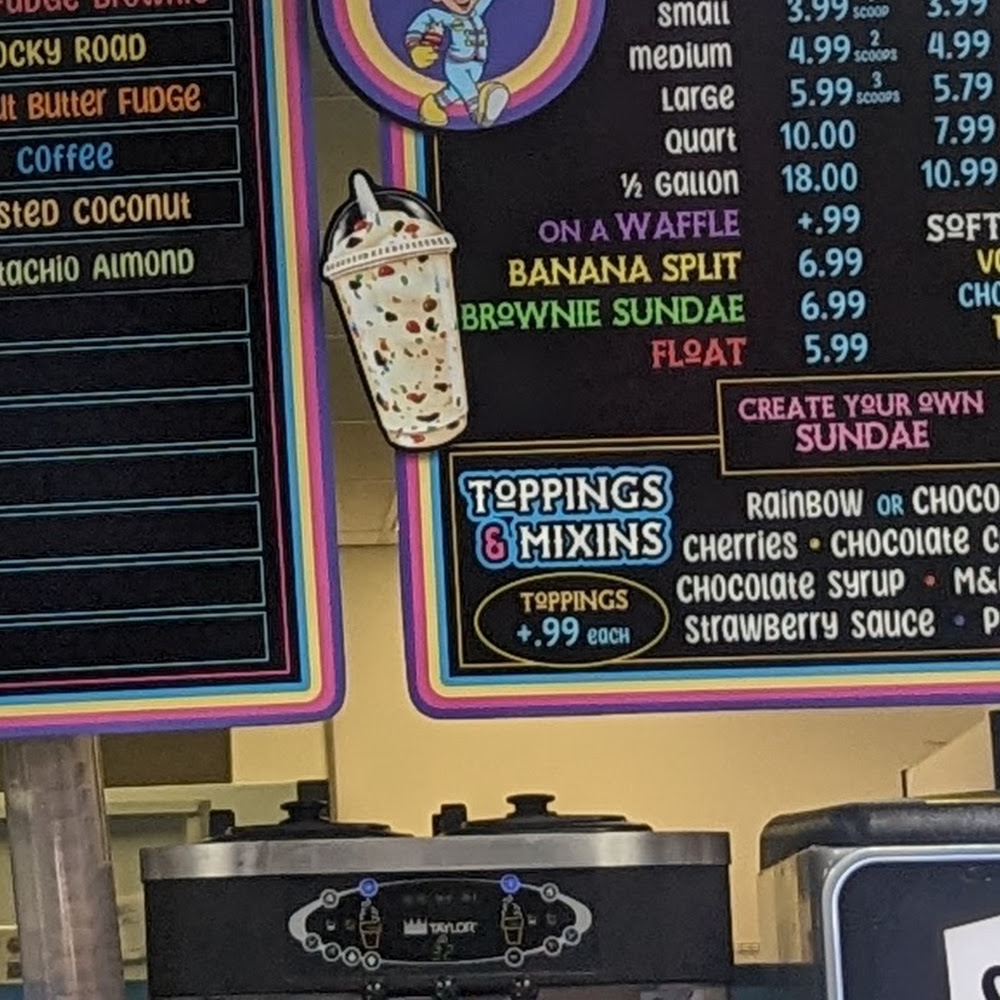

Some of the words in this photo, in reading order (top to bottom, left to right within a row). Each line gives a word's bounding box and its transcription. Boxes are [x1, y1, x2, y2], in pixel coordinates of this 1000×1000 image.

[852, 5, 890, 20] SCOOP
[74, 32, 147, 64] ROaD
[629, 40, 733, 71] MeDium
[788, 34, 851, 65] 4.99
[869, 29, 880, 47] 2
[927, 29, 991, 61] 4.99
[853, 48, 898, 63] SCOOPS
[661, 83, 735, 113] LarGe
[790, 77, 854, 108] 5.99
[871, 70, 882, 89] 3
[933, 71, 994, 102] 5.79
[27, 88, 107, 120] Butter
[117, 83, 201, 115] FUDGe
[856, 90, 901, 105] SCOOPS
[664, 124, 738, 155] Quart
[780, 118, 856, 151] 10.00
[934, 113, 996, 146] 7.99
[16, 141, 114, 175] Coffee
[654, 168, 740, 198] Gallon
[781, 161, 858, 193] 18.00
[920, 156, 1000, 189] 10.99
[73, 192, 192, 226] Coconut
[538, 220, 585, 244] ON
[590, 220, 609, 242] A
[615, 209, 741, 241] WAFFLE
[798, 204, 861, 236] +.99
[926, 212, 1000, 243] SOFT
[93, 247, 195, 281] Almond
[508, 253, 652, 289] BANANA
[662, 251, 742, 283] SPLIT
[799, 247, 863, 279] 6.99
[461, 298, 603, 332] BROWNIE
[612, 294, 746, 327] SUNDAE
[800, 290, 867, 323] 6.99
[651, 337, 747, 370] FLOAT
[804, 332, 869, 365] 5.99
[738, 395, 835, 422] CREATE
[845, 392, 913, 418] YOUR
[917, 390, 985, 416] OWN
[796, 419, 931, 453] SUNDAE
[466, 474, 667, 515] TOPPINGS
[747, 486, 864, 521] RainBOW
[876, 493, 905, 517] OR
[911, 483, 1000, 516] CHOCO
[484, 526, 506, 562] &
[519, 521, 666, 561] MIXINS
[683, 530, 797, 564] CHerries
[830, 525, 971, 558] CHOCOlate
[520, 589, 629, 615] TOPPINGS
[676, 570, 816, 604] CHOCOlate
[827, 567, 905, 600] syrup
[953, 566, 1000, 595] M&
[517, 615, 582, 648] +.99
[586, 624, 630, 646] eaCH
[684, 608, 839, 645] StrawBerry
[850, 607, 936, 640] sauce
